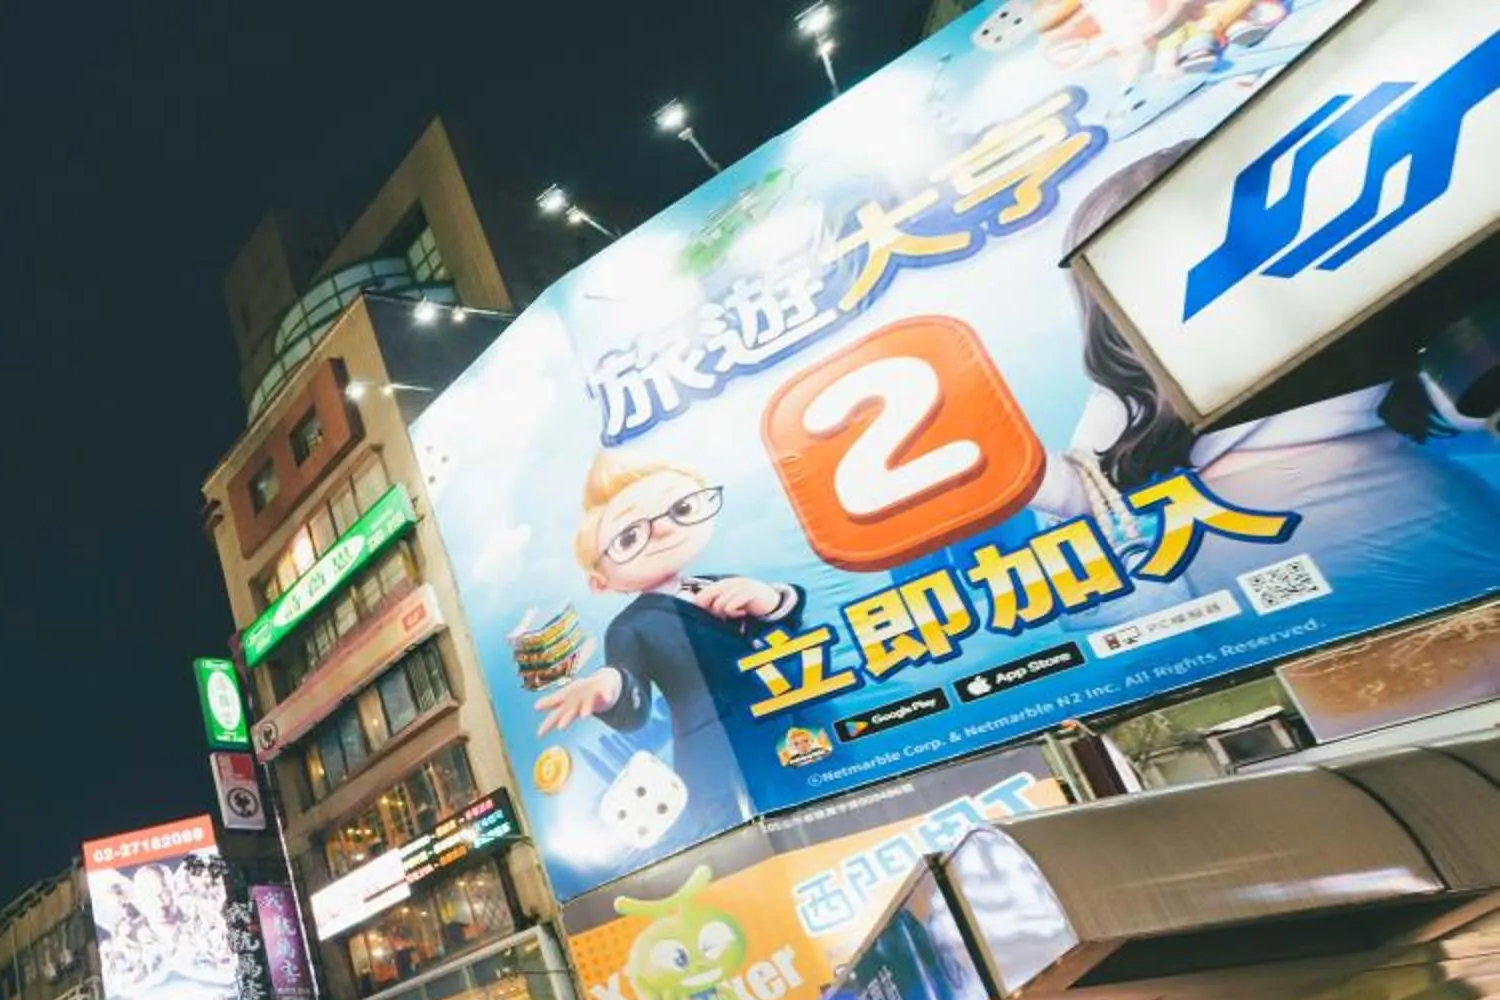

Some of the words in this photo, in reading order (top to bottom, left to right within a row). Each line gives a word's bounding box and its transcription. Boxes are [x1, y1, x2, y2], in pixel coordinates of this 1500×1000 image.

[803, 355, 984, 517] 2
[739, 472, 1299, 718] 立即加入
[995, 664, 1028, 685] App
[1030, 651, 1072, 673] Store
[902, 738, 946, 758] Corp.
[949, 731, 961, 743] &
[965, 703, 1055, 738] Netmarble
[1058, 693, 1081, 708] N2
[1085, 682, 1121, 699] Inc.
[1125, 671, 1149, 689] All
[1153, 652, 1218, 679] Rights
[1220, 617, 1326, 657] Reserved.
